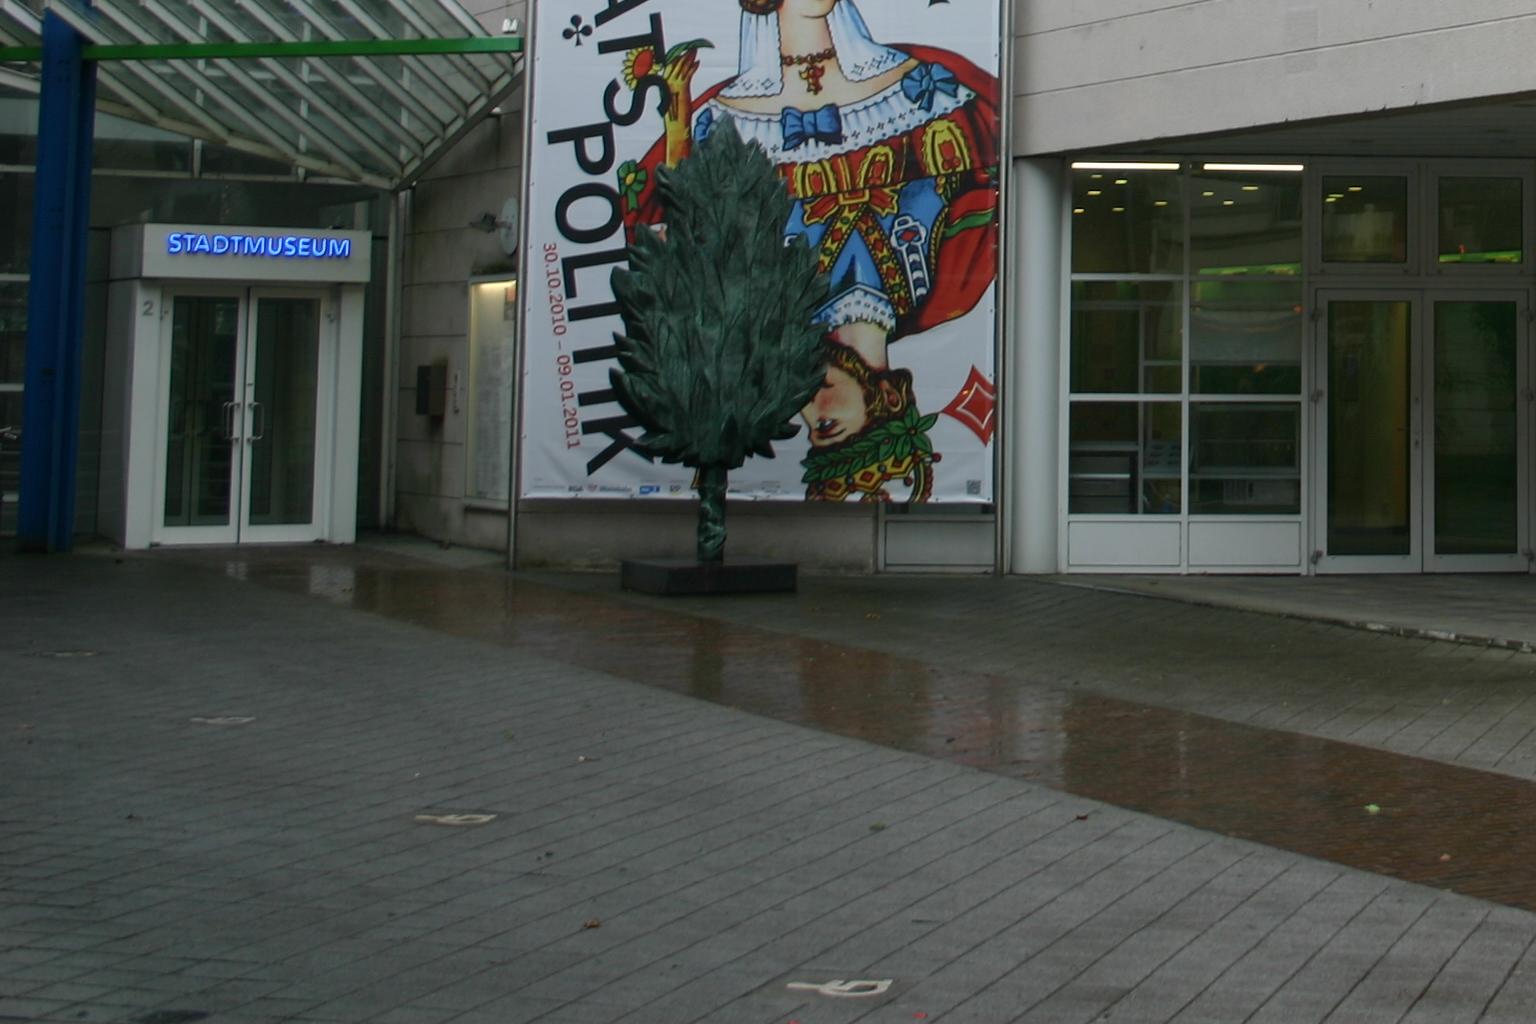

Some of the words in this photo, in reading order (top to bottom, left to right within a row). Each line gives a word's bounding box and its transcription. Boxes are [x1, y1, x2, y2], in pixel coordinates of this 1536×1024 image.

[168, 232, 351, 257] STADTMUSEUM
[142, 300, 154, 316] 2
[543, 243, 568, 336] 30.10.2010
[556, 354, 581, 450] 09.01.2011
